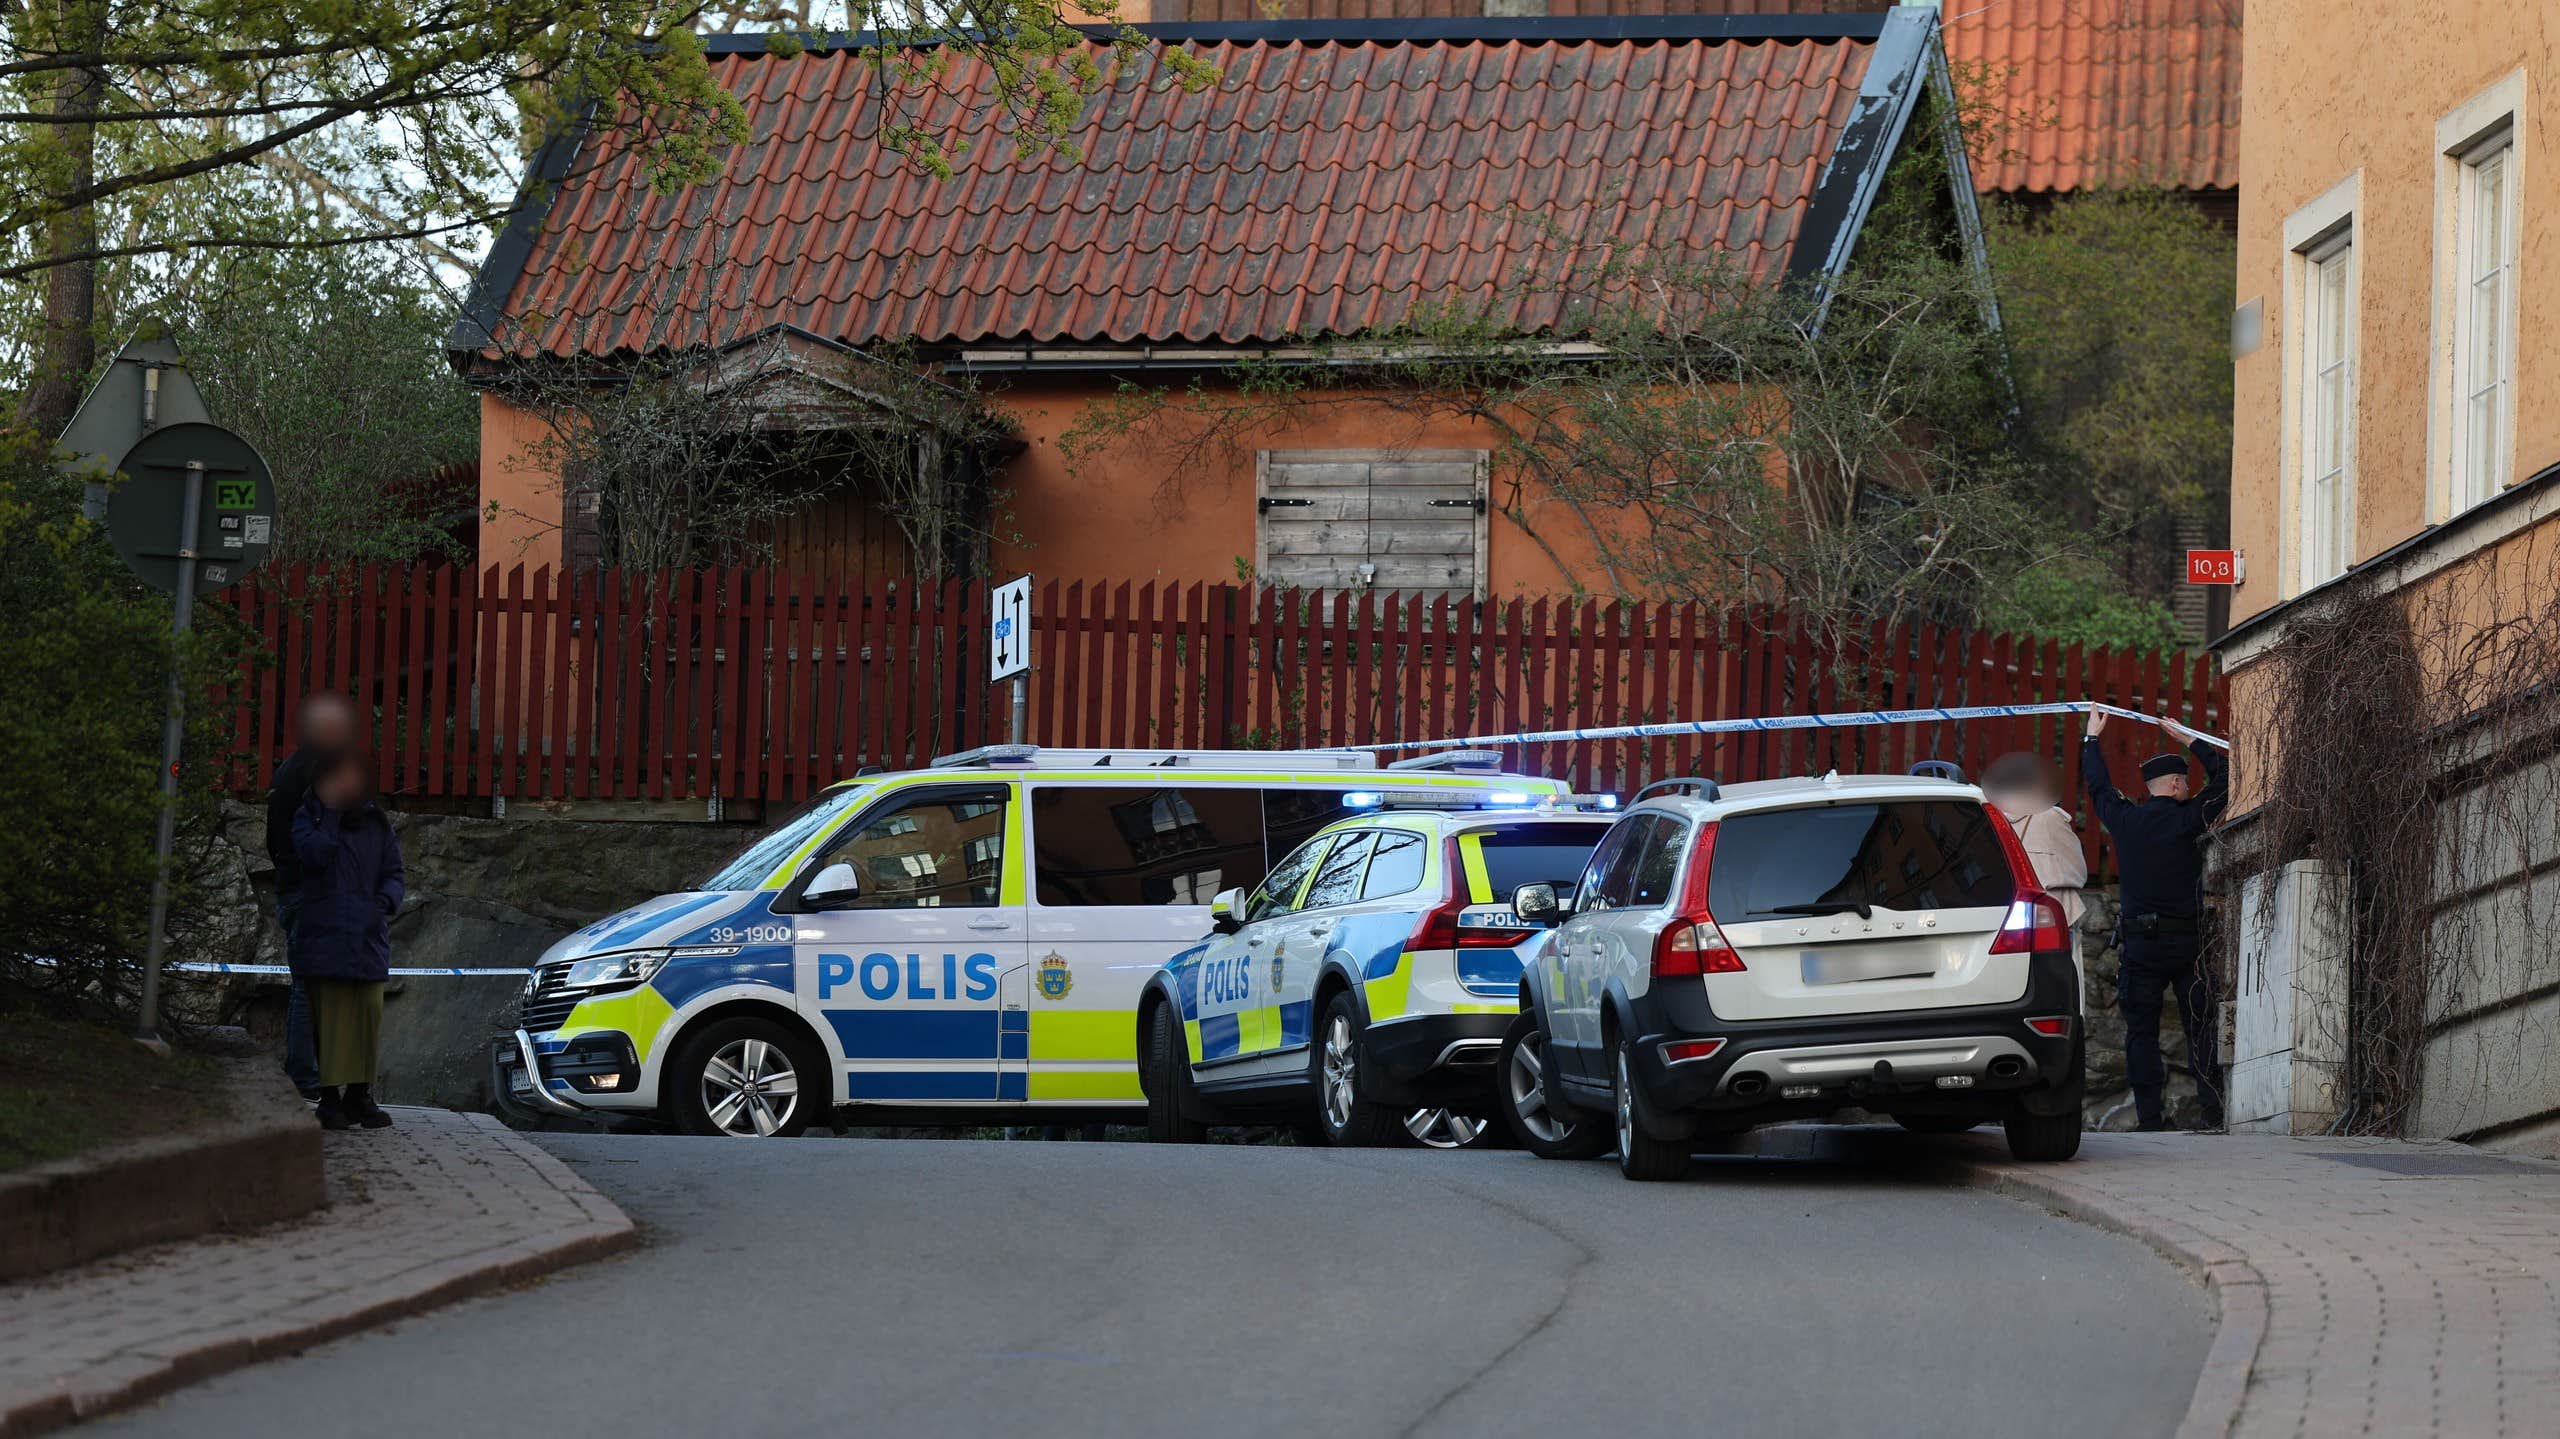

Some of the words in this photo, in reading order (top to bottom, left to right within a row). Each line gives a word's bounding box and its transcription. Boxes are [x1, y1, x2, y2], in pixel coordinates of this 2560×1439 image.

[218, 485, 254, 504] F.Y.
[710, 926, 790, 943] 39-1900
[818, 952, 998, 1001] POLIS
[1204, 954, 1251, 1006] POLIS
